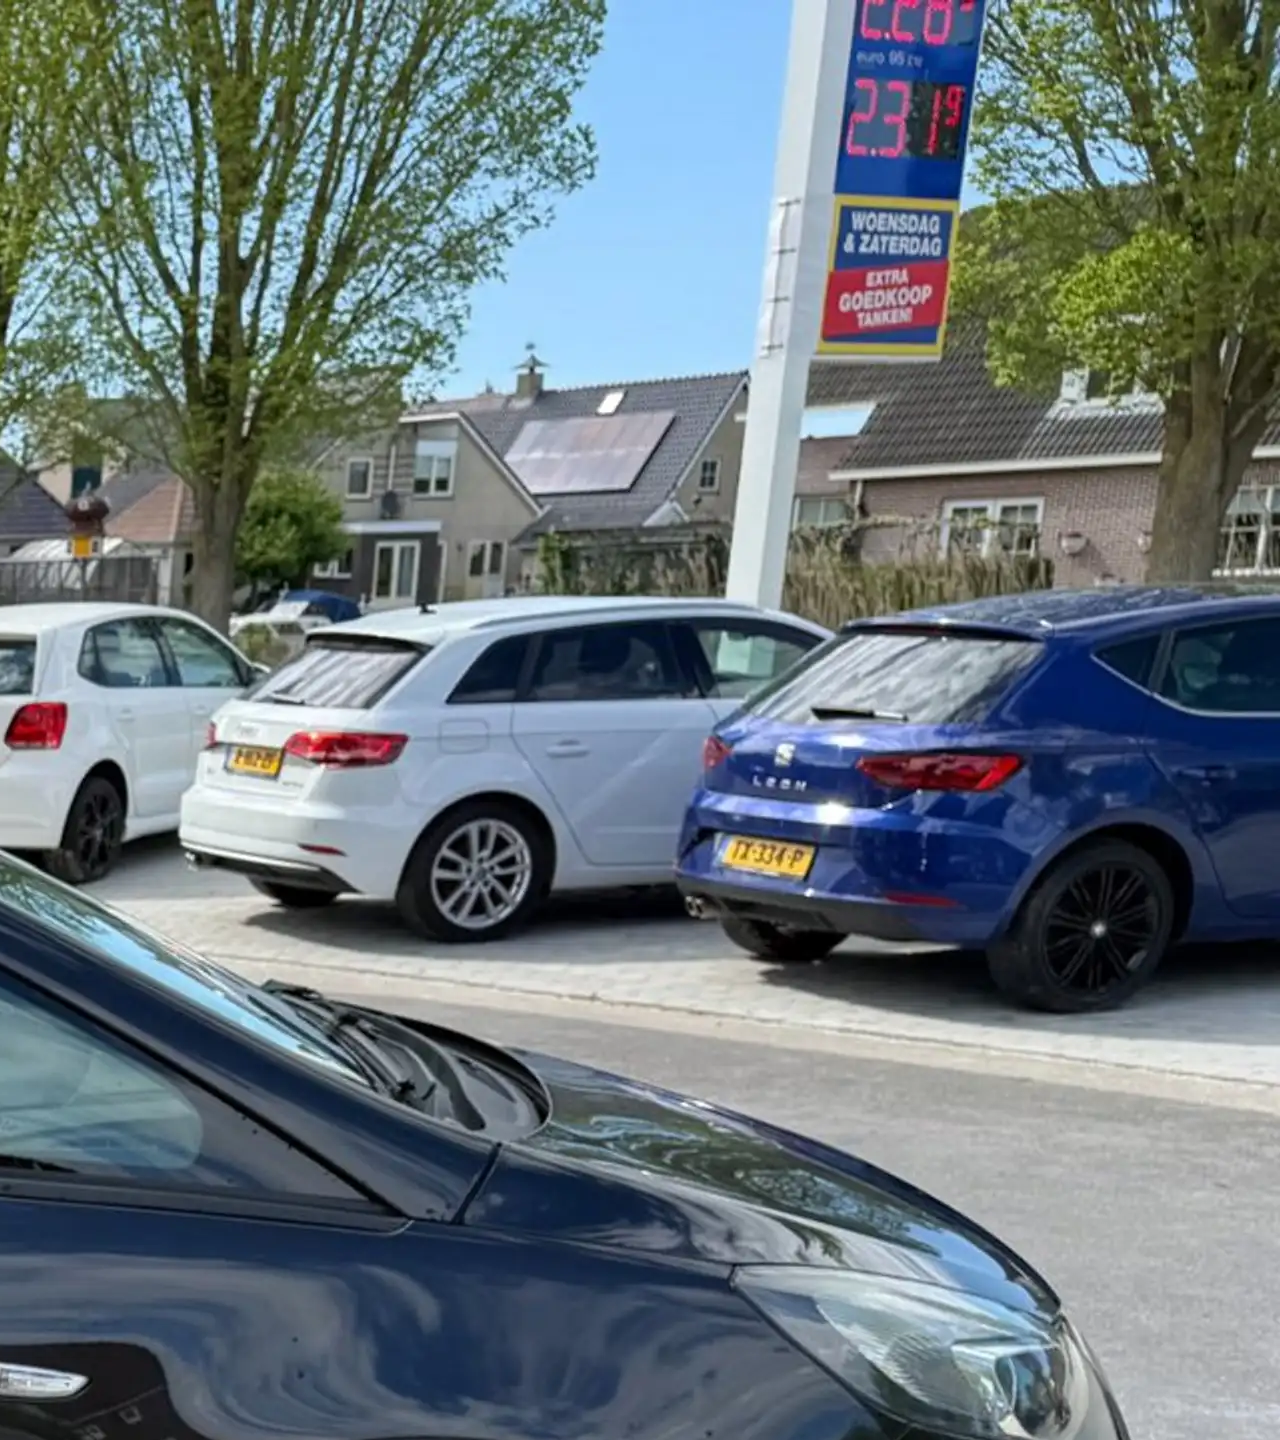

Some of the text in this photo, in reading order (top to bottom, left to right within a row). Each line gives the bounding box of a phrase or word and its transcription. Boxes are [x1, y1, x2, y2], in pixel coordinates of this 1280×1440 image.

[851, 211, 941, 235] WOENSDAG
[843, 233, 943, 257] & ZATERDAG
[865, 267, 909, 288] EXTRA
[838, 284, 933, 313] GOEDKOOP
